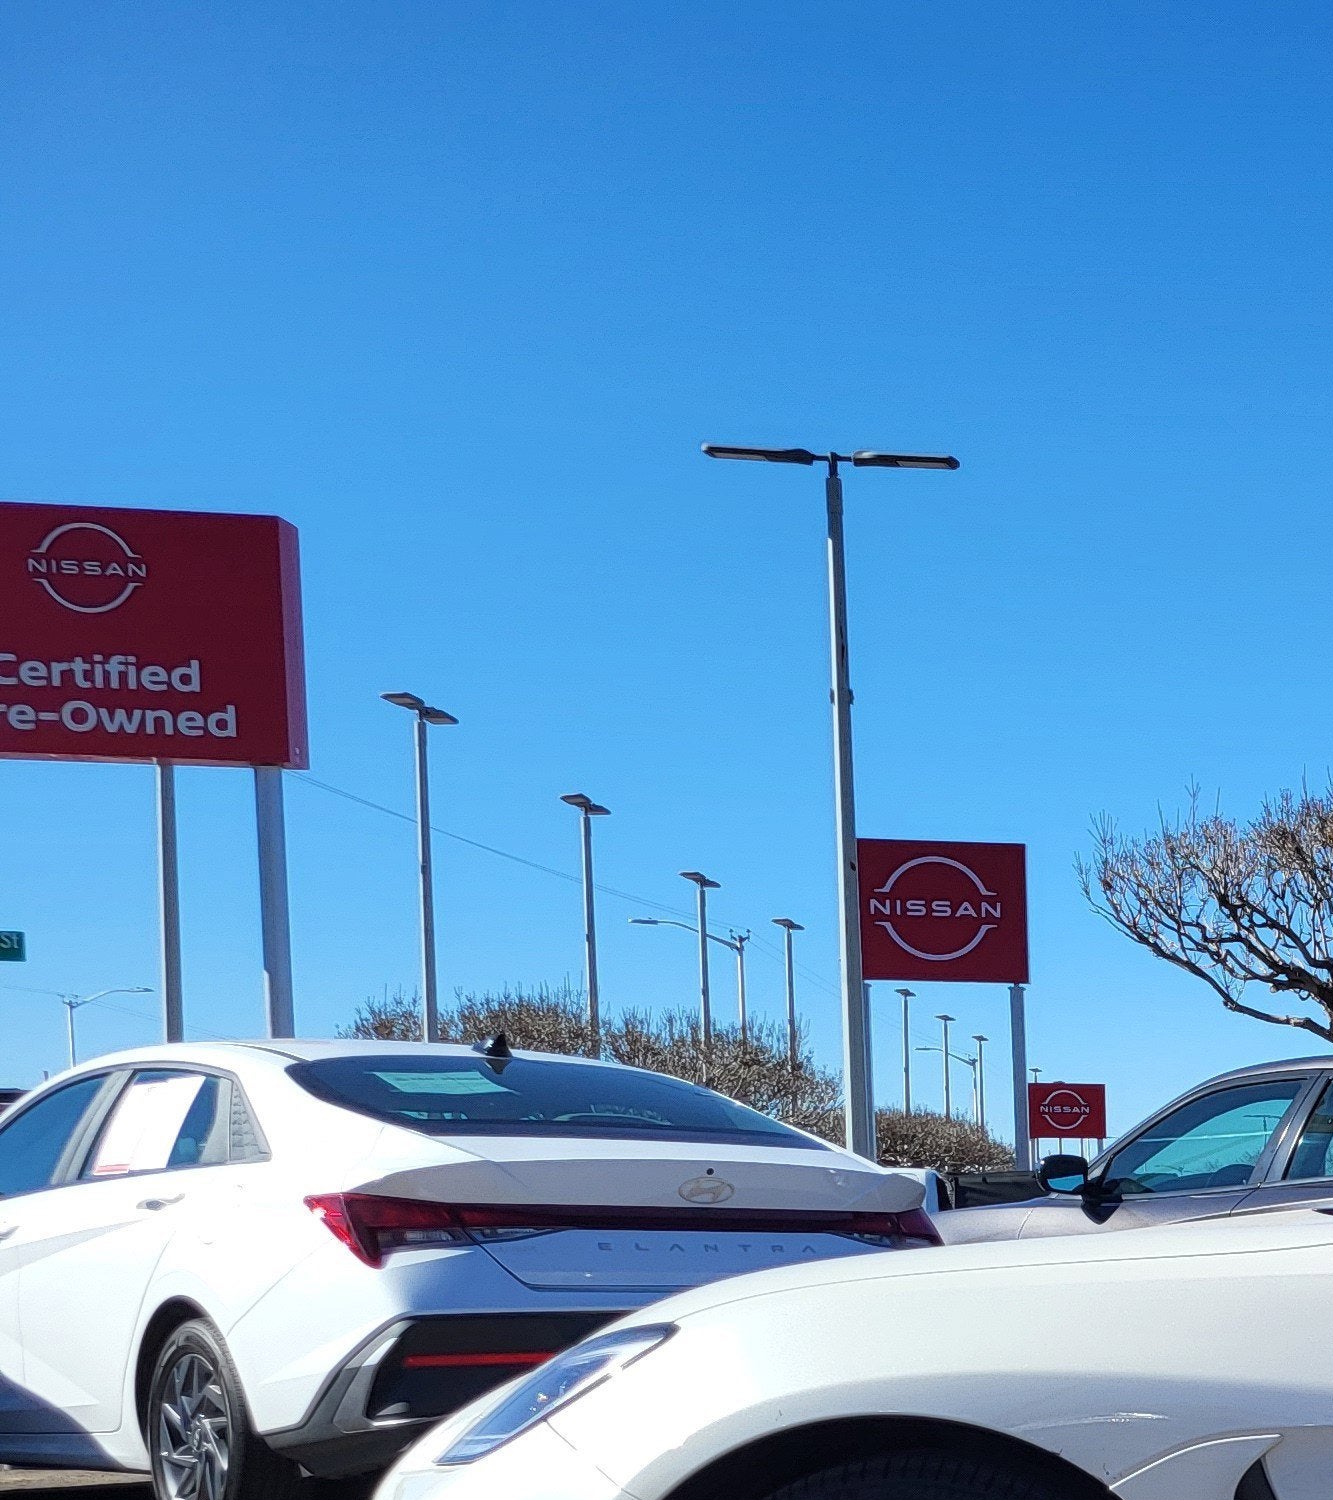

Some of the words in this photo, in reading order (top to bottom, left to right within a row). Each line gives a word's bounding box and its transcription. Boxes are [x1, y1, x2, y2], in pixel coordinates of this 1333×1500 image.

[27, 558, 147, 577] NISSAN
[0, 653, 201, 693] Certified
[0, 700, 238, 738] e-Owned
[870, 898, 1001, 918] NISSAN
[1040, 1105, 1090, 1114] NISSAN
[598, 1241, 816, 1254] ELANTRA
